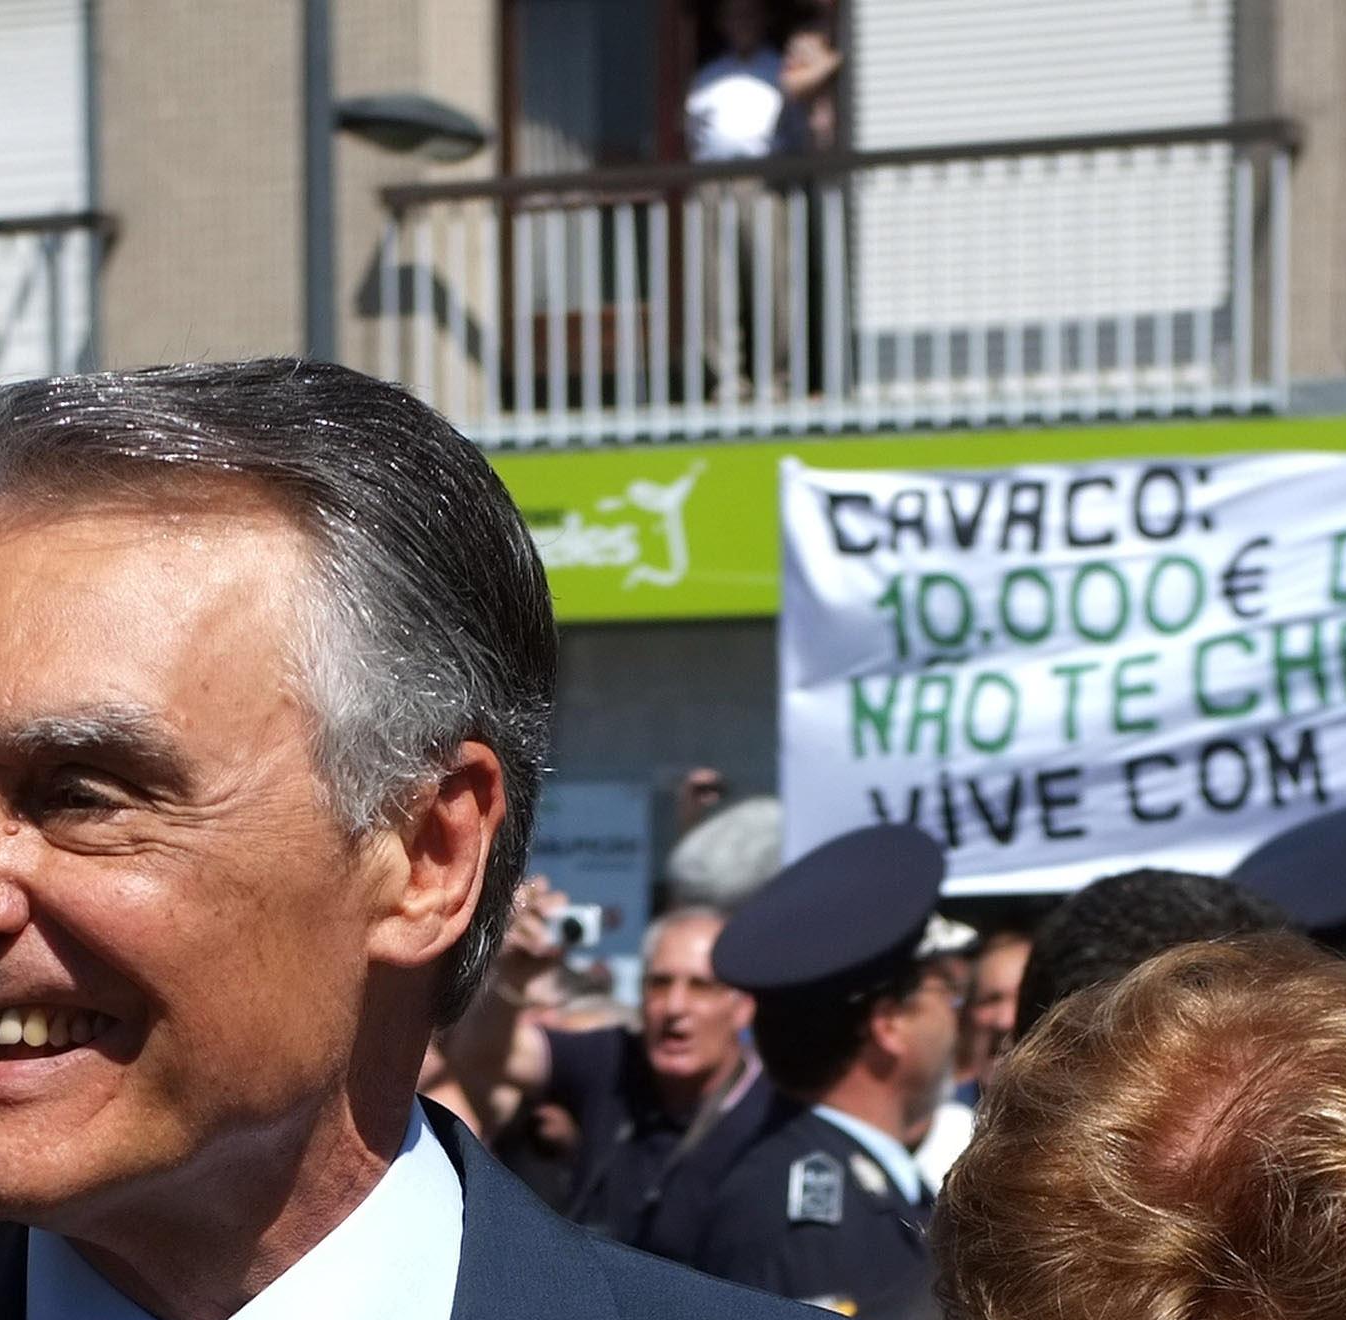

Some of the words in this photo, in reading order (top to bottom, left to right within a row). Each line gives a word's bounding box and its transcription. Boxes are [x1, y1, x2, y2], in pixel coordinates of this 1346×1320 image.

[825, 465, 1216, 556] CAVACO:
[874, 536, 1273, 662] 10.000€
[851, 653, 1020, 760] NÃO
[1050, 652, 1162, 744] TE
[867, 766, 1088, 850] VIVE
[1123, 727, 1328, 823] COM
